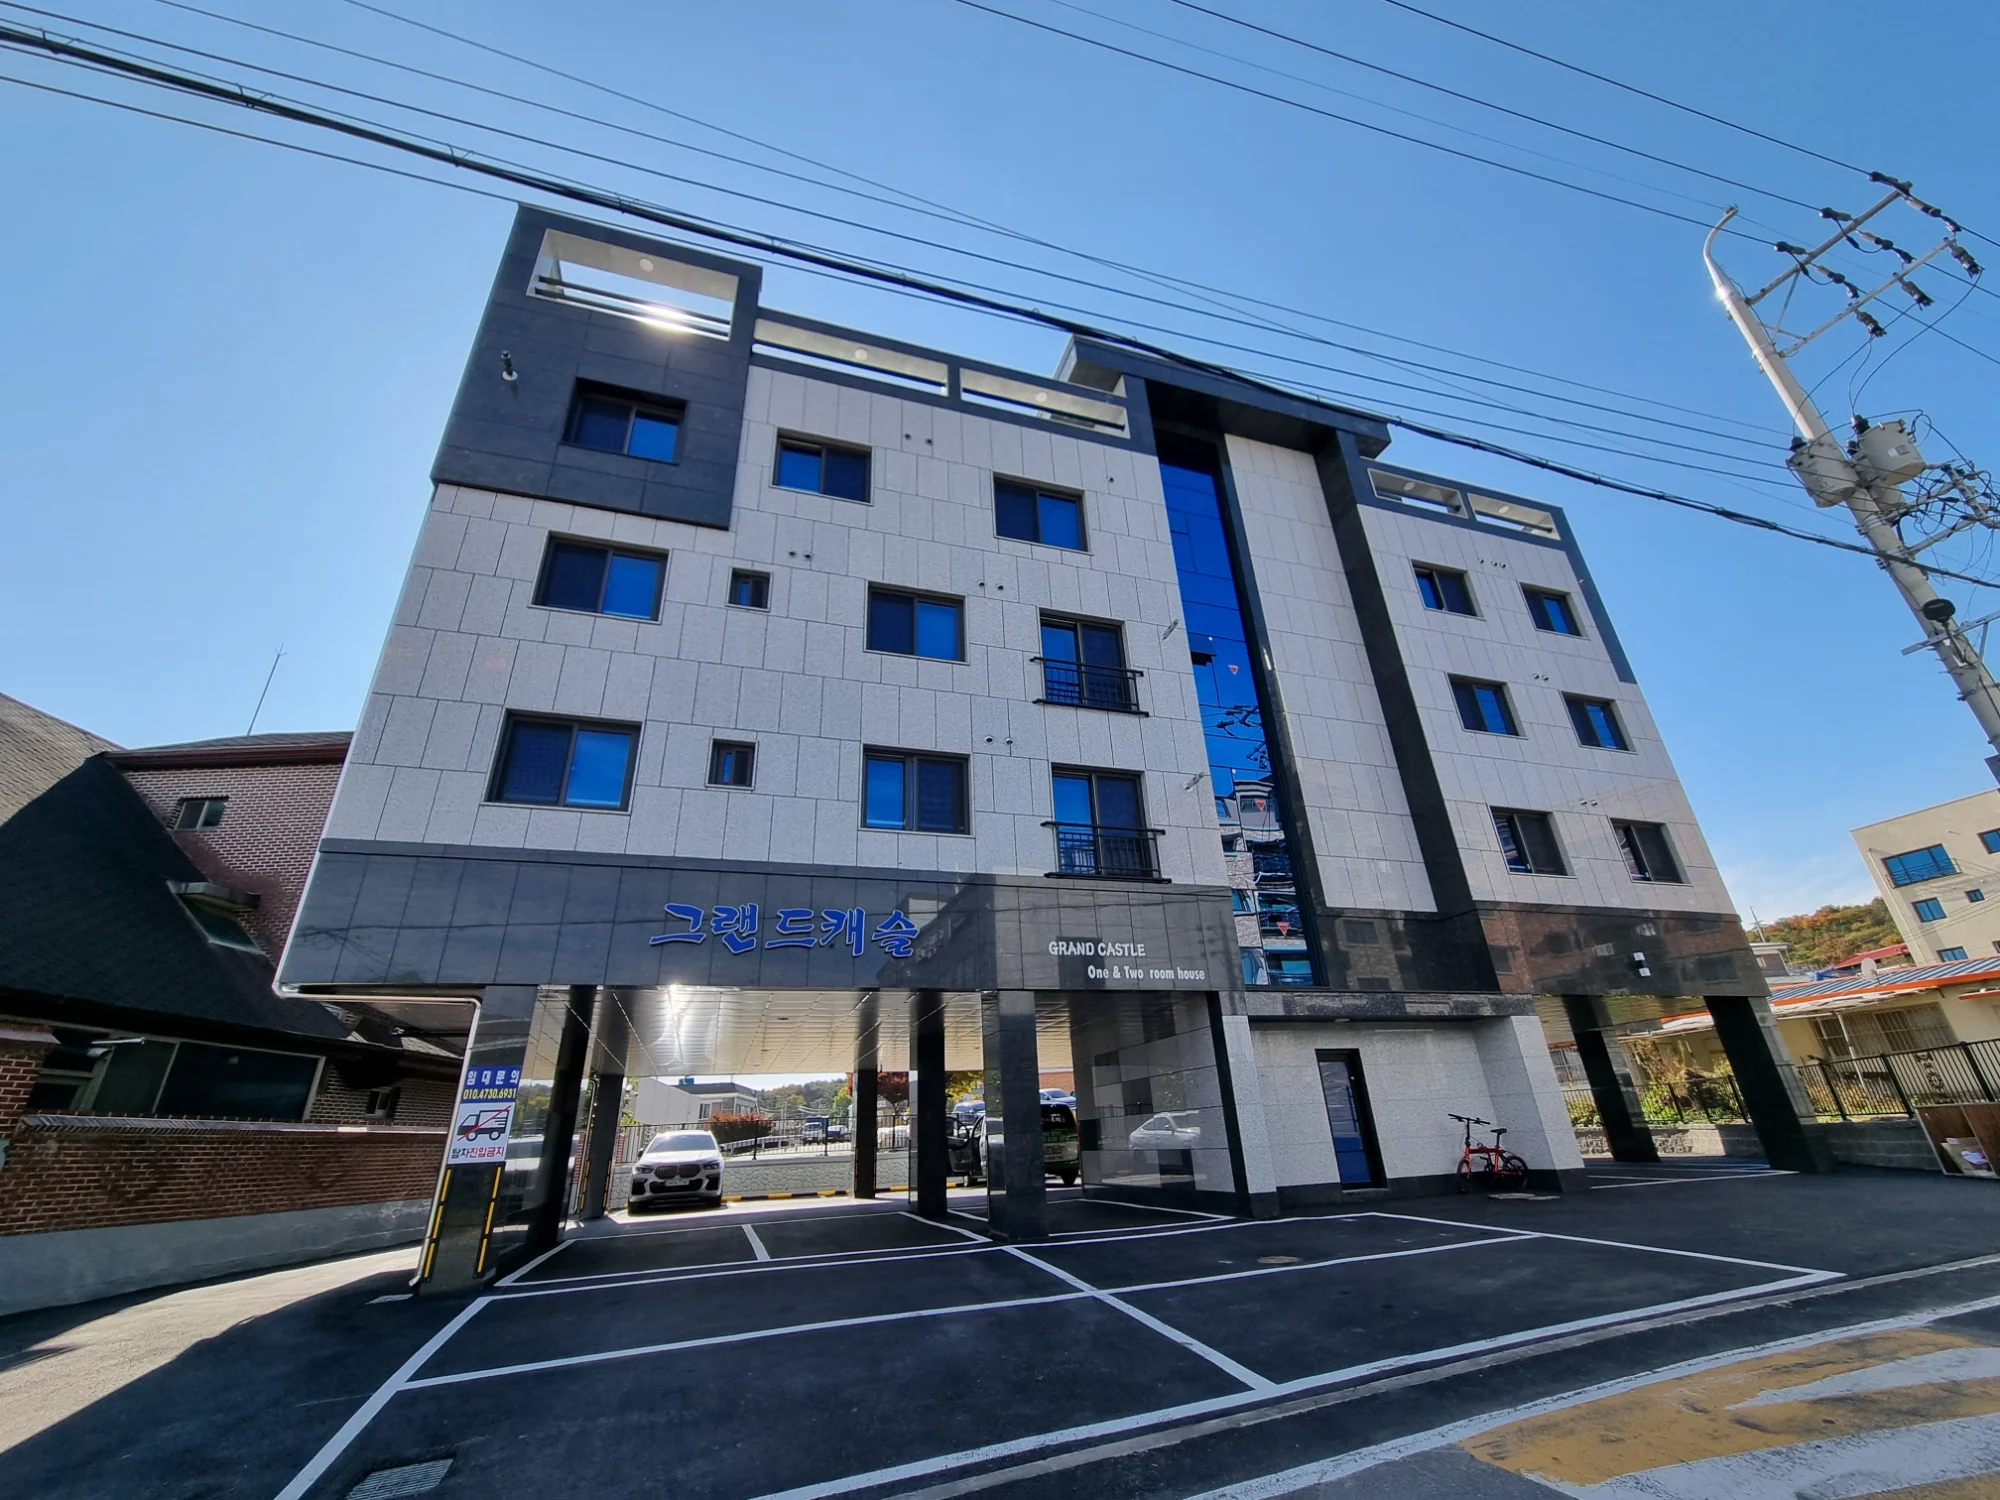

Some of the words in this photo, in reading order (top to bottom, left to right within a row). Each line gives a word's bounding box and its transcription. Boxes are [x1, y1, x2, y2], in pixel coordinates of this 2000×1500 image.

[649, 902, 921, 957] 그랜드캐슬
[1049, 941, 1095, 956] GRAND
[1097, 943, 1146, 957] CASTLE
[1087, 964, 1110, 979] One
[1112, 965, 1121, 978] &
[1123, 966, 1144, 979] Two
[1149, 969, 1175, 980] room
[1177, 966, 1205, 980] house
[463, 1088, 517, 1099] 010.4730.6931
